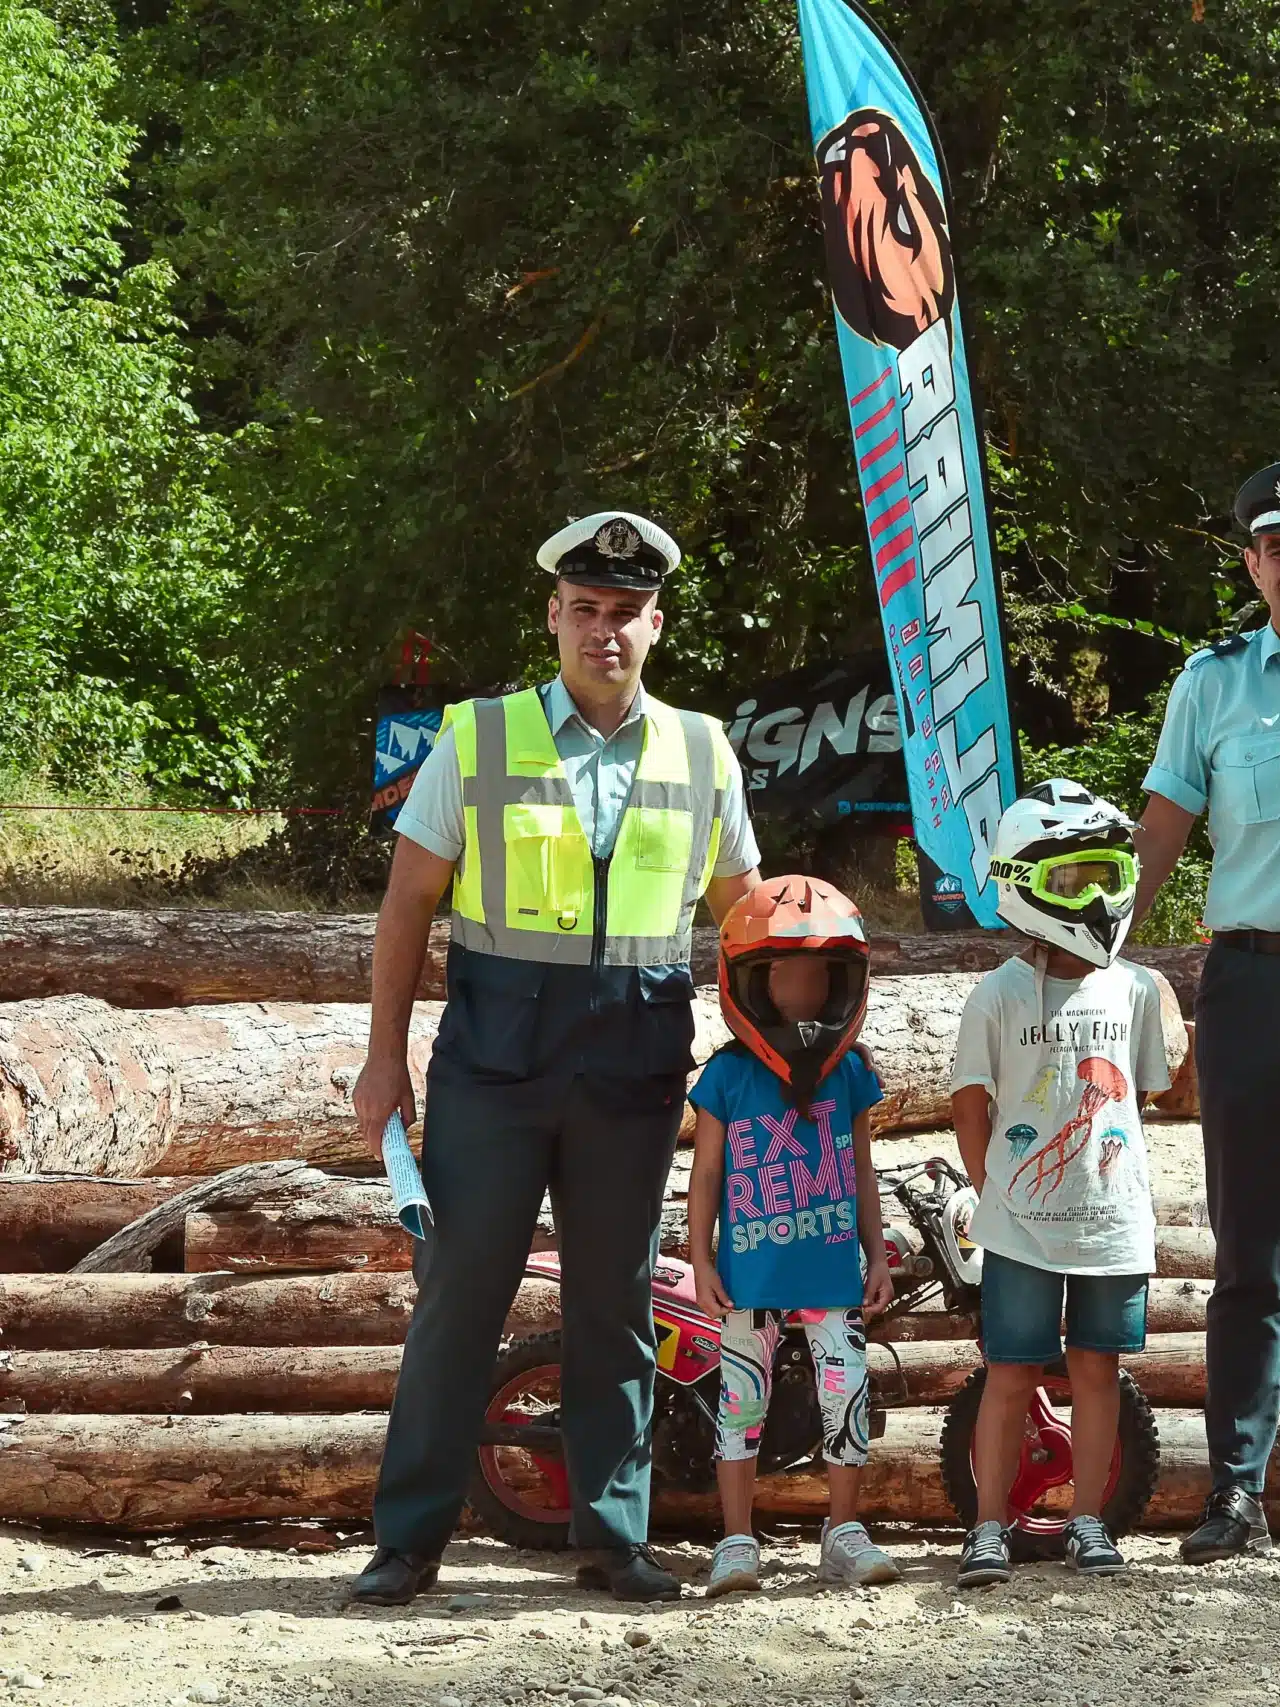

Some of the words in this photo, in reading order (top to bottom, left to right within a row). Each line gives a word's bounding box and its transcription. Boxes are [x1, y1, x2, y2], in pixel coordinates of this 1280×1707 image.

[1019, 1022, 1079, 1047] JELLY
[1092, 1021, 1128, 1042] FISH
[731, 1200, 855, 1255] SPORTS
